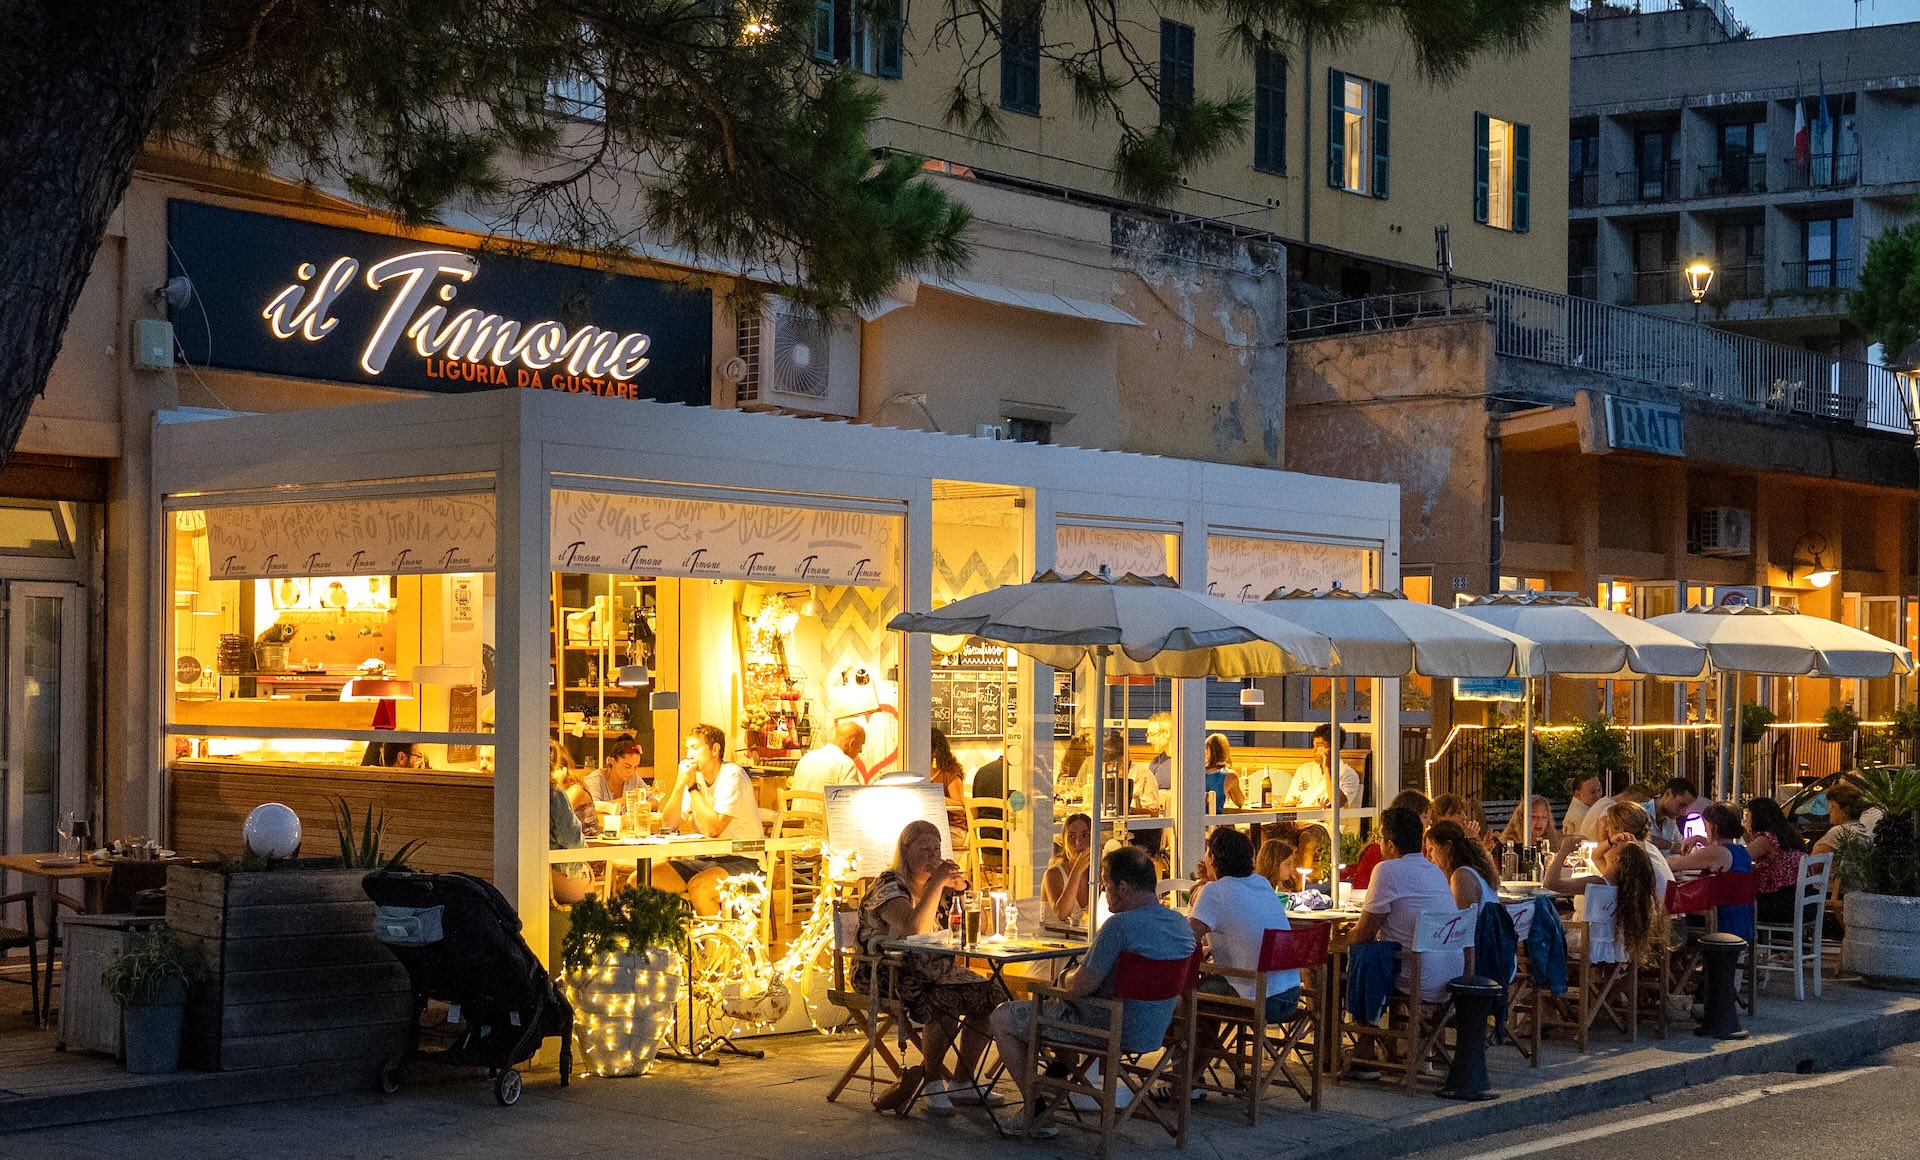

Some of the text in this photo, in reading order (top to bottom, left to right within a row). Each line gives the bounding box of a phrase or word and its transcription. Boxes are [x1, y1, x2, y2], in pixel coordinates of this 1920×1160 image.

[262, 249, 652, 381] il Timone
[426, 358, 639, 401] LIGURIA DA GUSTARE
[558, 541, 601, 567] il Timone
[621, 545, 663, 570] il Timone
[682, 548, 721, 573] il Timone
[740, 552, 777, 577] il Timone
[794, 555, 831, 579] il Timone
[847, 558, 882, 582] il Timone
